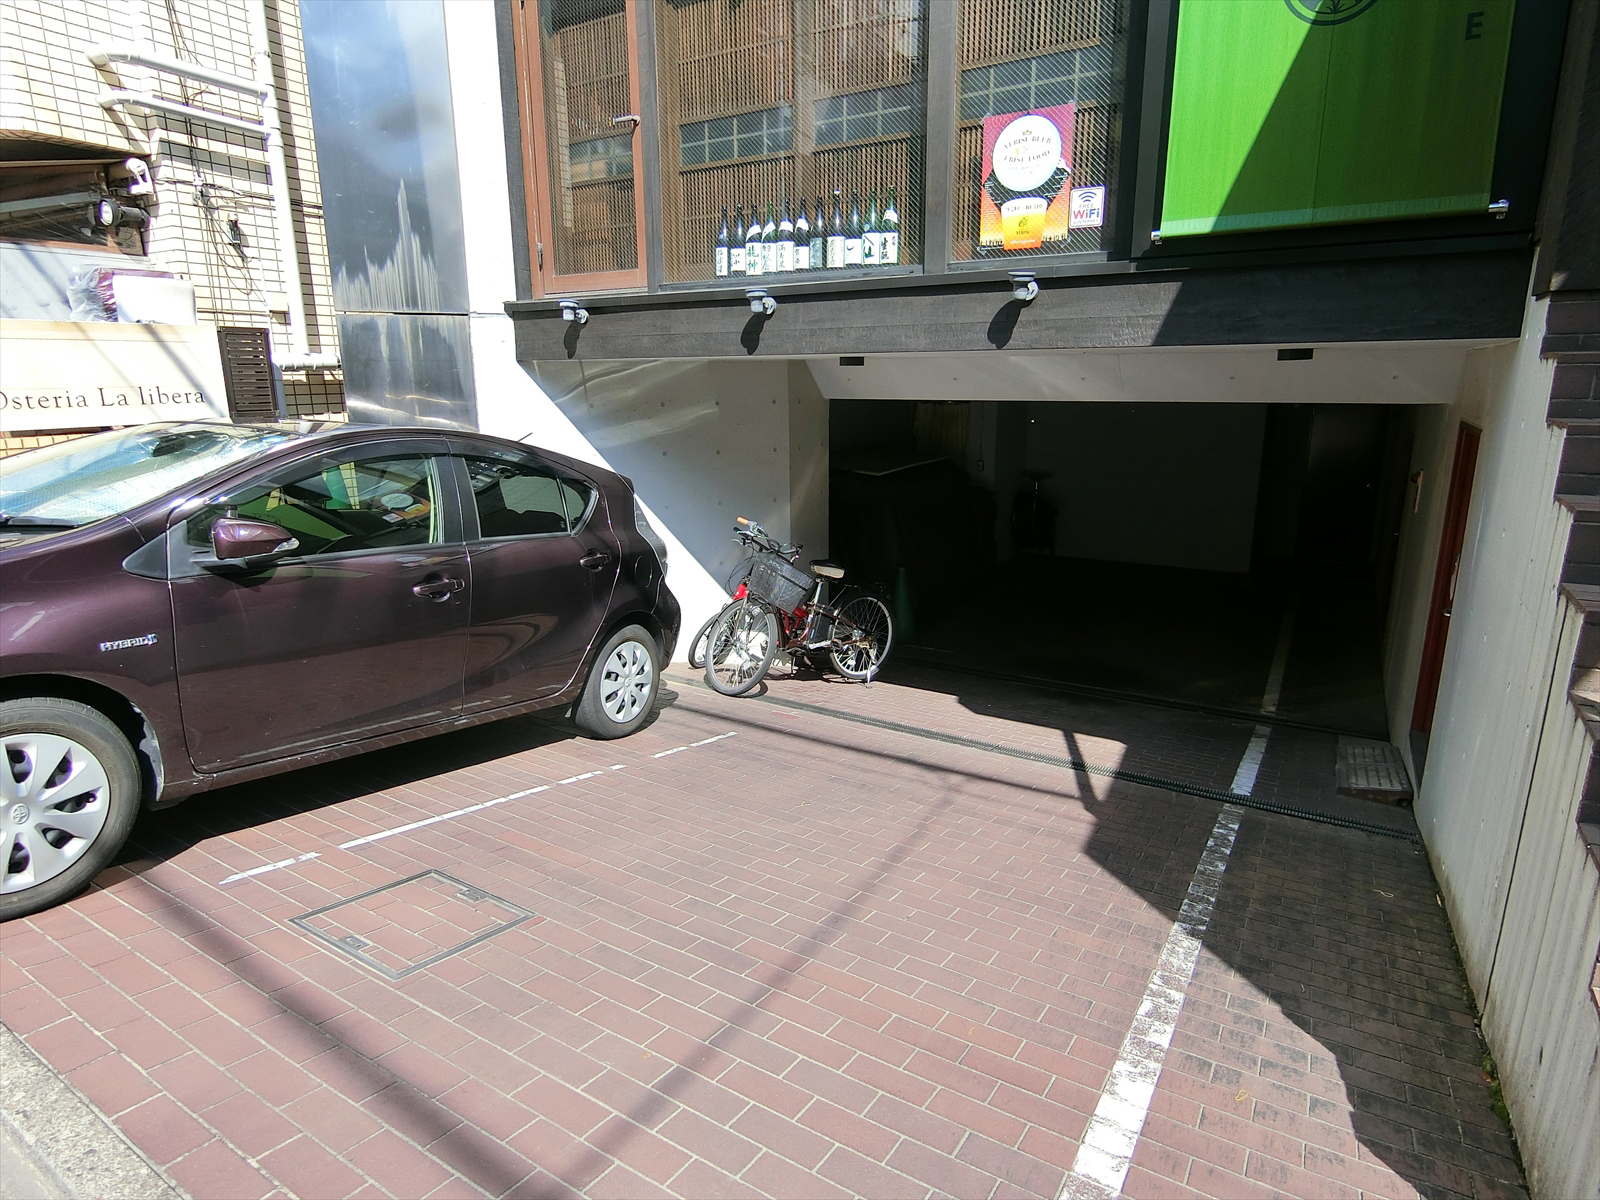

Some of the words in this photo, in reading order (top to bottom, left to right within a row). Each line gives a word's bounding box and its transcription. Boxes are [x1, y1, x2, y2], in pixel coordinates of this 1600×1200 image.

[1465, 11, 1485, 41] E
[1073, 208, 1100, 219] WiFi
[97, 387, 129, 407] La
[138, 386, 206, 405] libera
